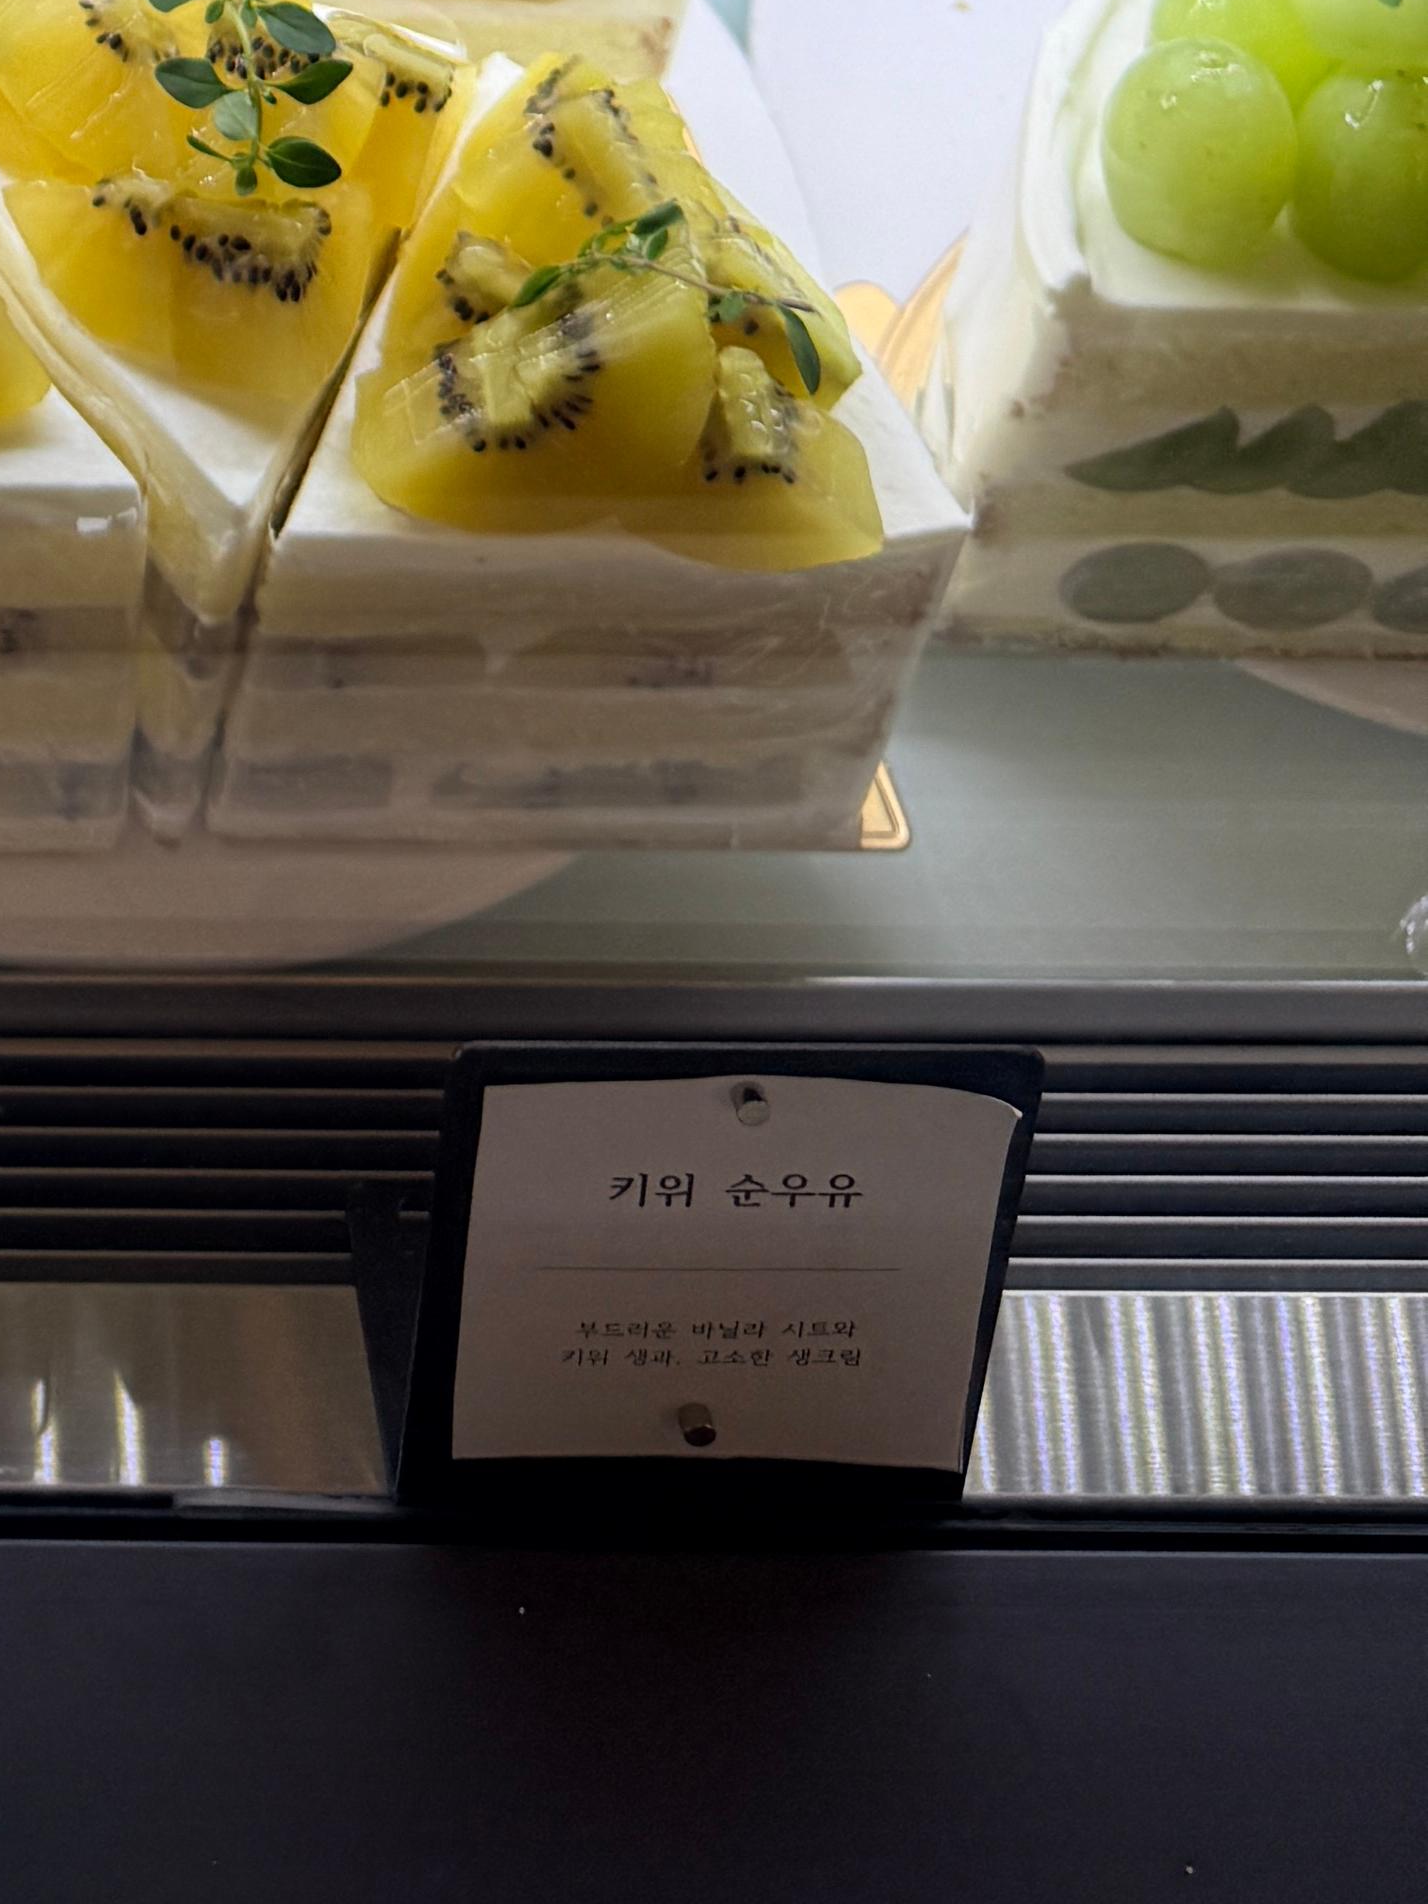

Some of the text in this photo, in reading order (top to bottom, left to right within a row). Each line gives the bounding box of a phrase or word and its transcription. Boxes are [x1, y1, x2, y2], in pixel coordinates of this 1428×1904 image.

[609, 1172, 863, 1209] 키위 순우유
[580, 1320, 856, 1340] 부드러운 바닐라 시트와
[562, 1348, 609, 1367] 키위
[697, 1348, 771, 1368] 고소한
[788, 1348, 861, 1367] 생크림
